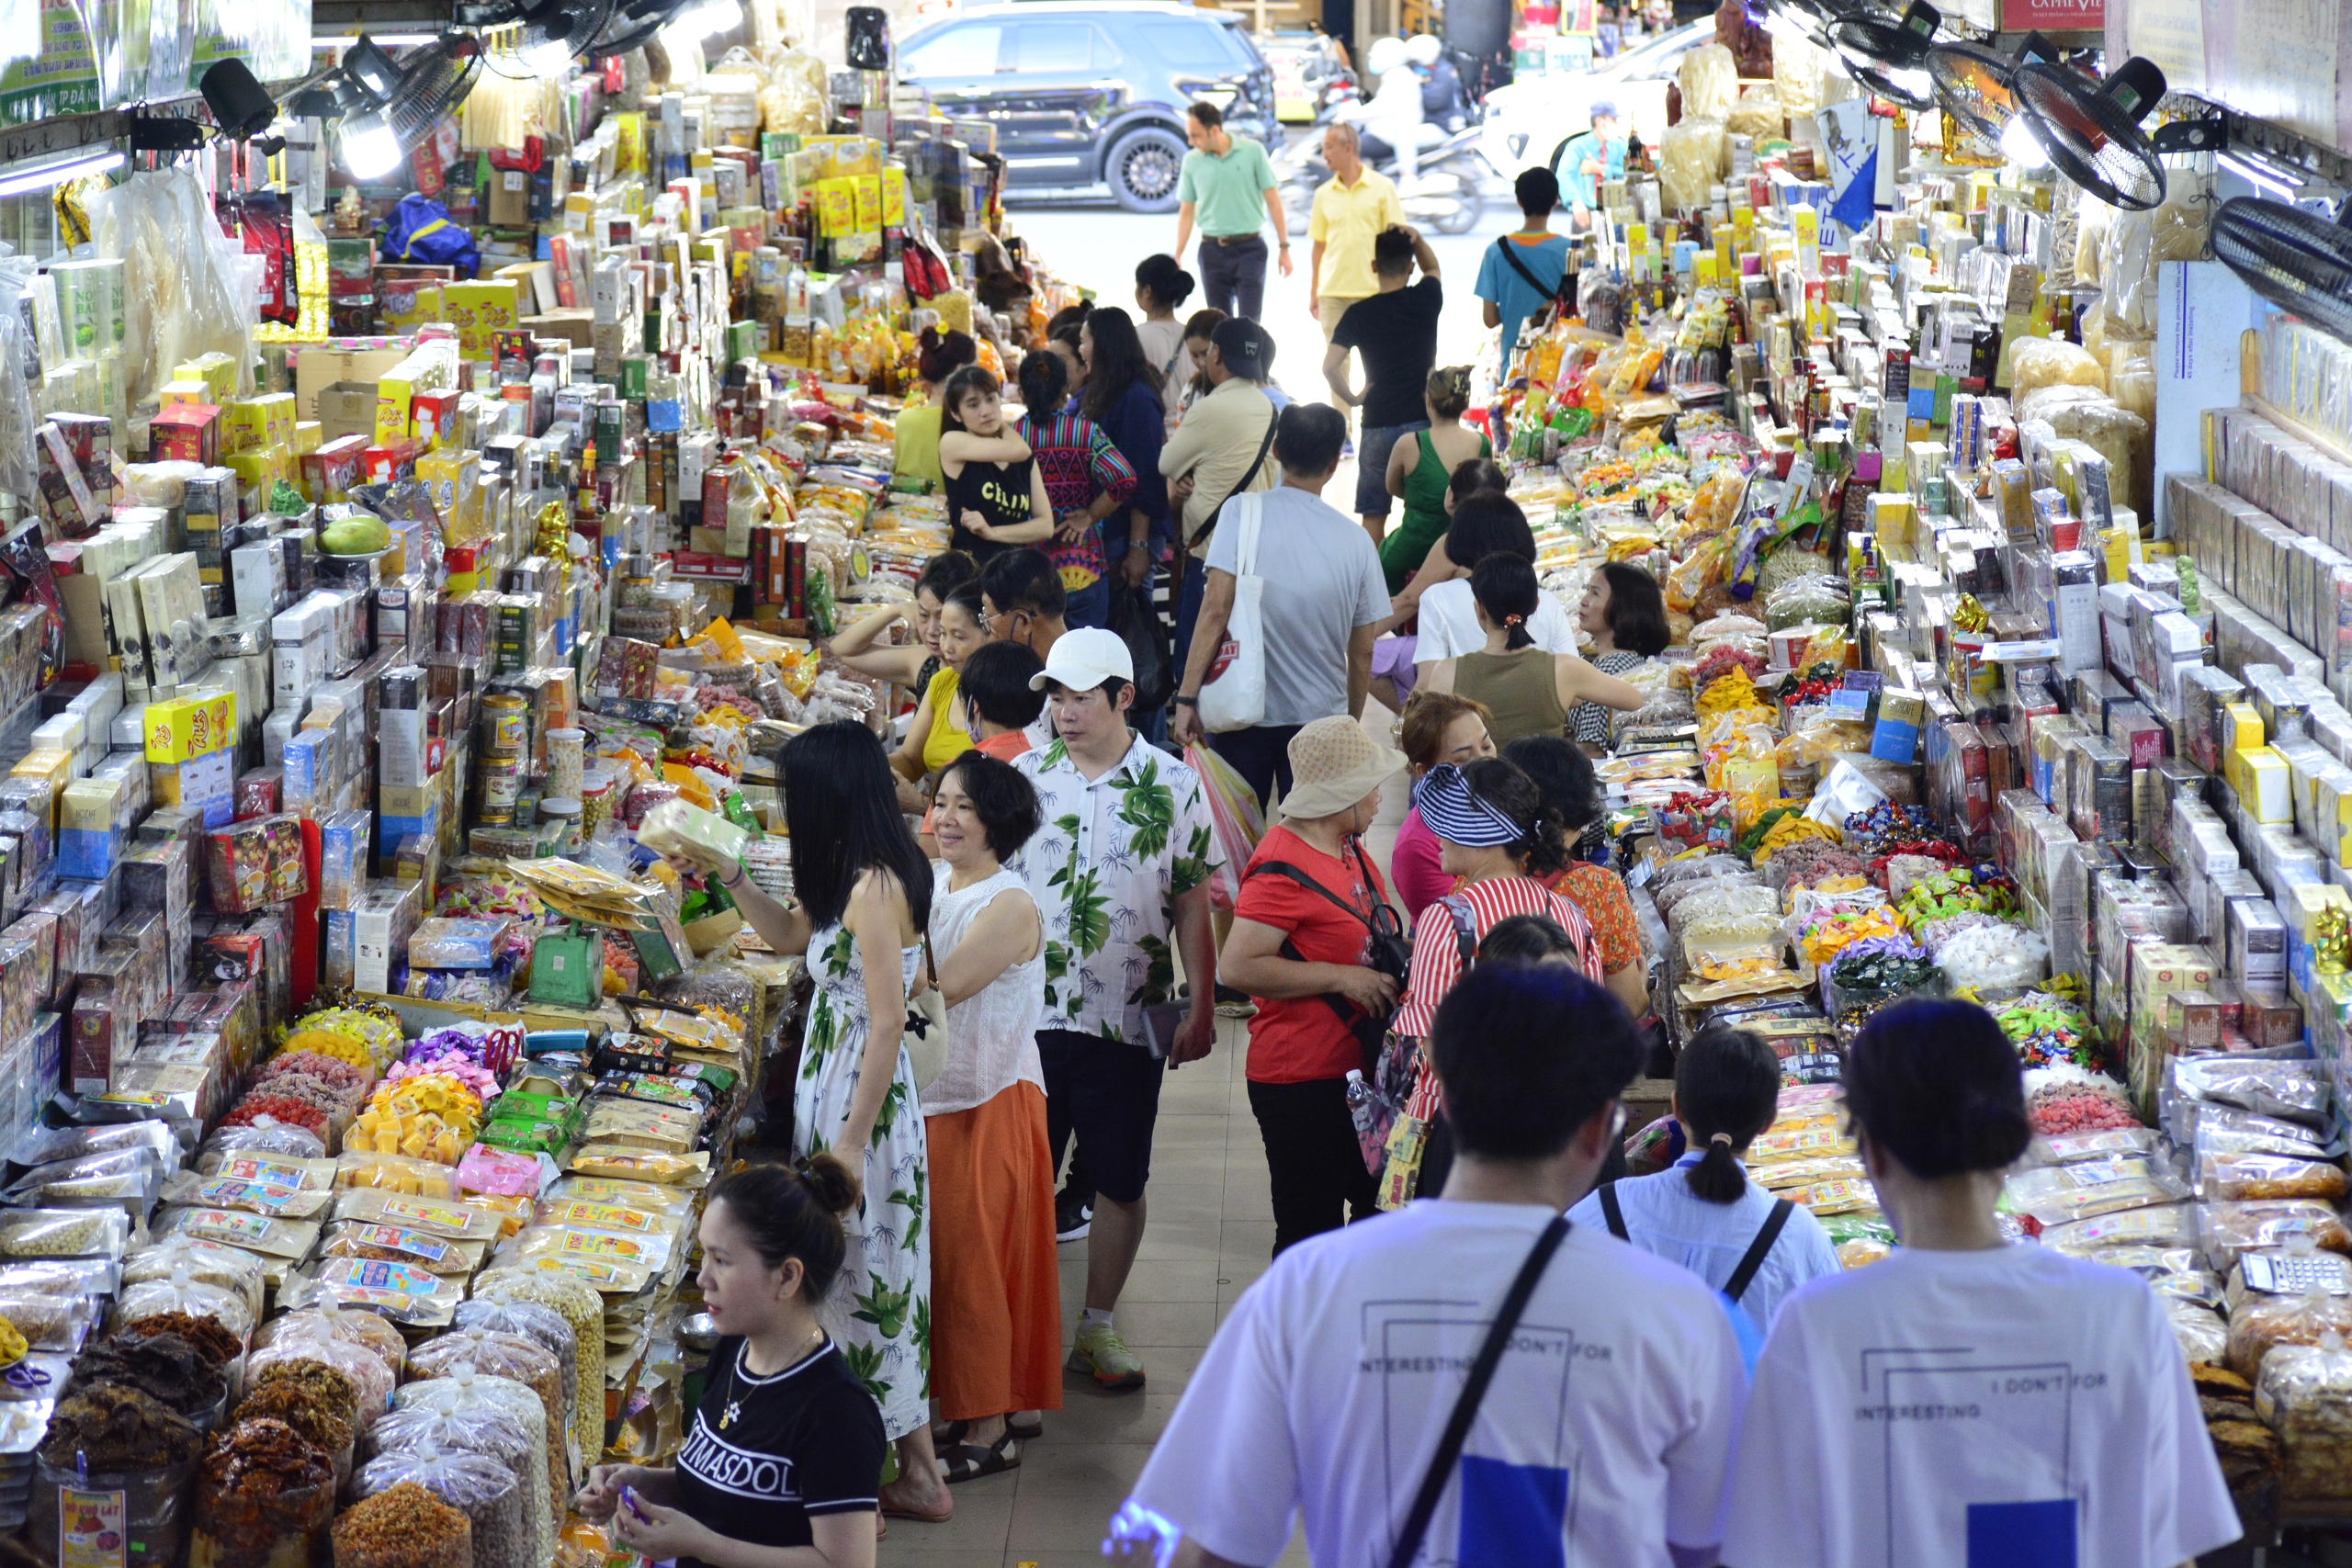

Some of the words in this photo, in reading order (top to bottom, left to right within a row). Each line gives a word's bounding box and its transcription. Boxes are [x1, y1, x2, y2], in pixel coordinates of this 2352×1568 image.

[70, 85, 85, 104] ĐÀ
[2005, 1376, 2064, 1394] DON'T
[1854, 1403, 1981, 1421] INTERESTING
